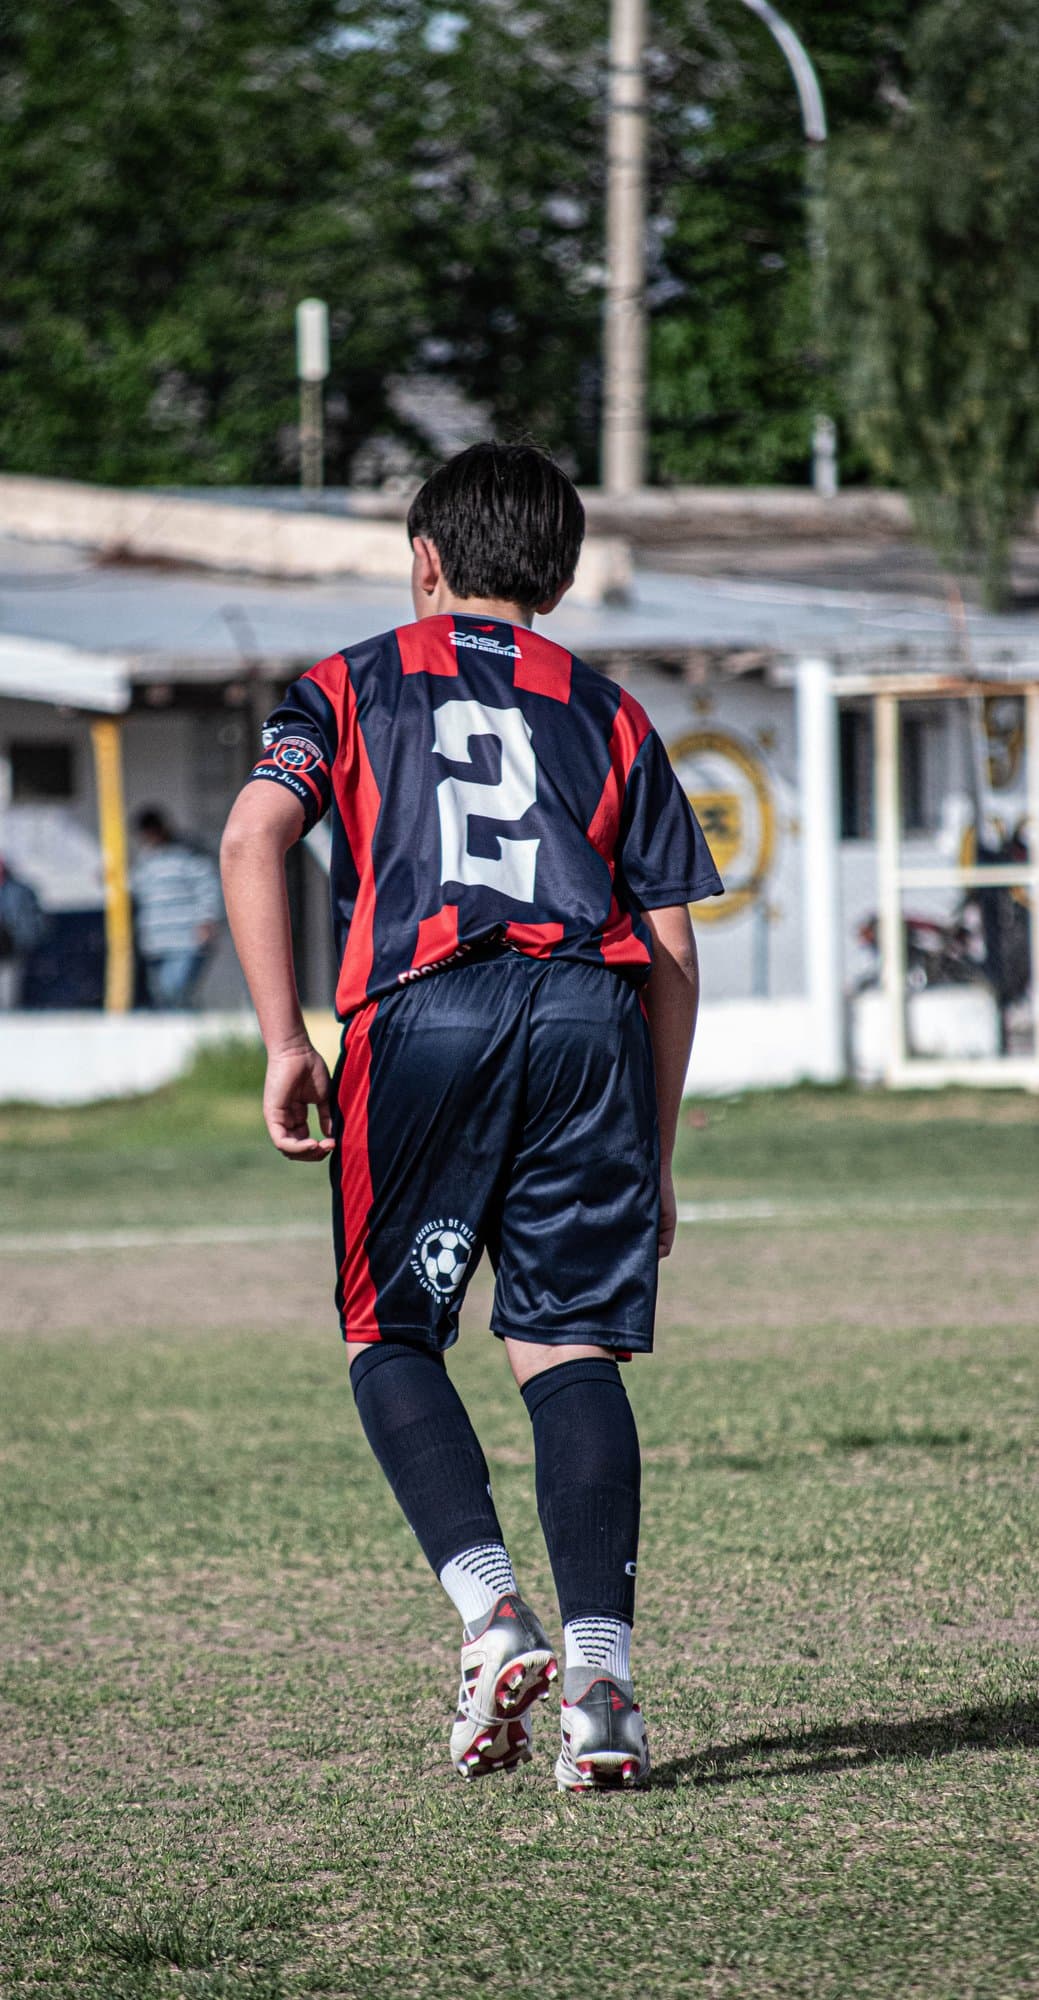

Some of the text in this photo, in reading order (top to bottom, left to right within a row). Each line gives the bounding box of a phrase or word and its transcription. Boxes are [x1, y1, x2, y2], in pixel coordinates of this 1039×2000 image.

[447, 631, 522, 653] CASLA
[431, 700, 541, 904] 2
[415, 1218, 446, 1244] ESCUELA
[448, 1218, 460, 1229] DE
